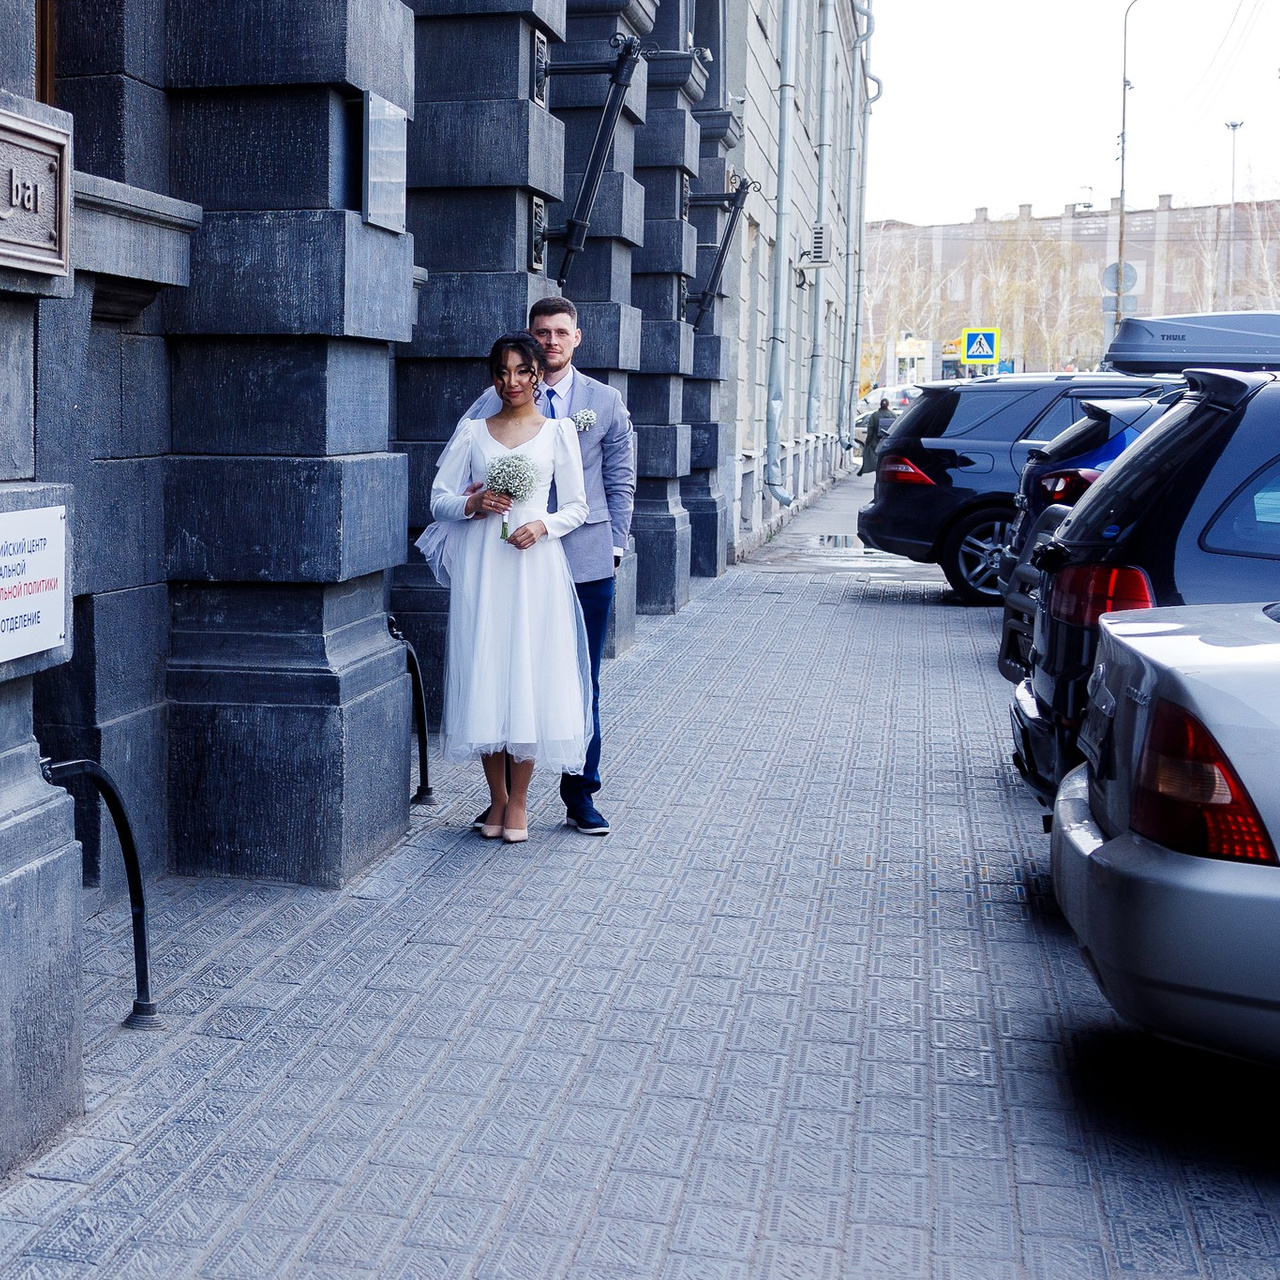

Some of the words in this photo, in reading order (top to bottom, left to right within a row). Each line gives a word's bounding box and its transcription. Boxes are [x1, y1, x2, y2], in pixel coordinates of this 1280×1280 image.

[10, 168, 44, 213] bar
[27, 538, 47, 556] ЦЕНТР
[23, 578, 58, 595] ПОЛИТИКИ
[0, 610, 41, 634] ОТДЕЛЕНИЕ
